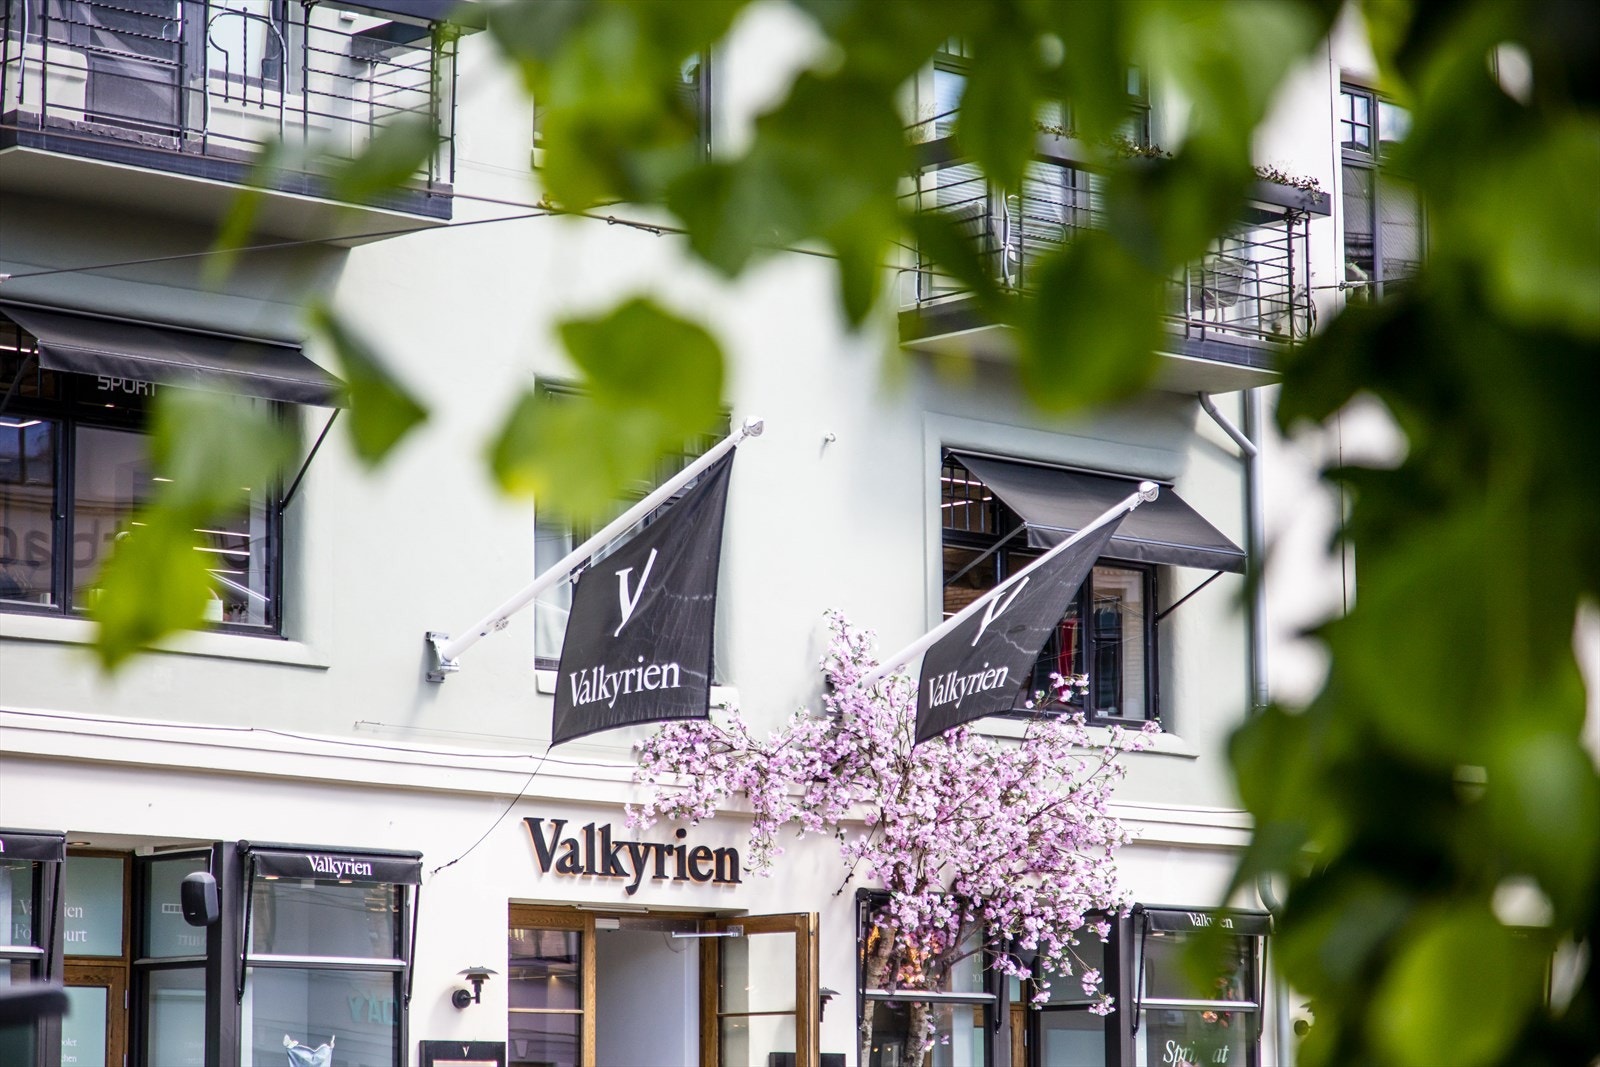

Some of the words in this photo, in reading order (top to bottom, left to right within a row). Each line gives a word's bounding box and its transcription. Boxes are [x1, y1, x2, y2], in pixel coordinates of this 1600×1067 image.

[569, 655, 681, 709] Valkyrien
[928, 661, 1009, 709] Valkyrien
[306, 855, 372, 879] Valkyrien
[523, 816, 743, 896] Valkyrien
[1212, 1044, 1229, 1063] at
